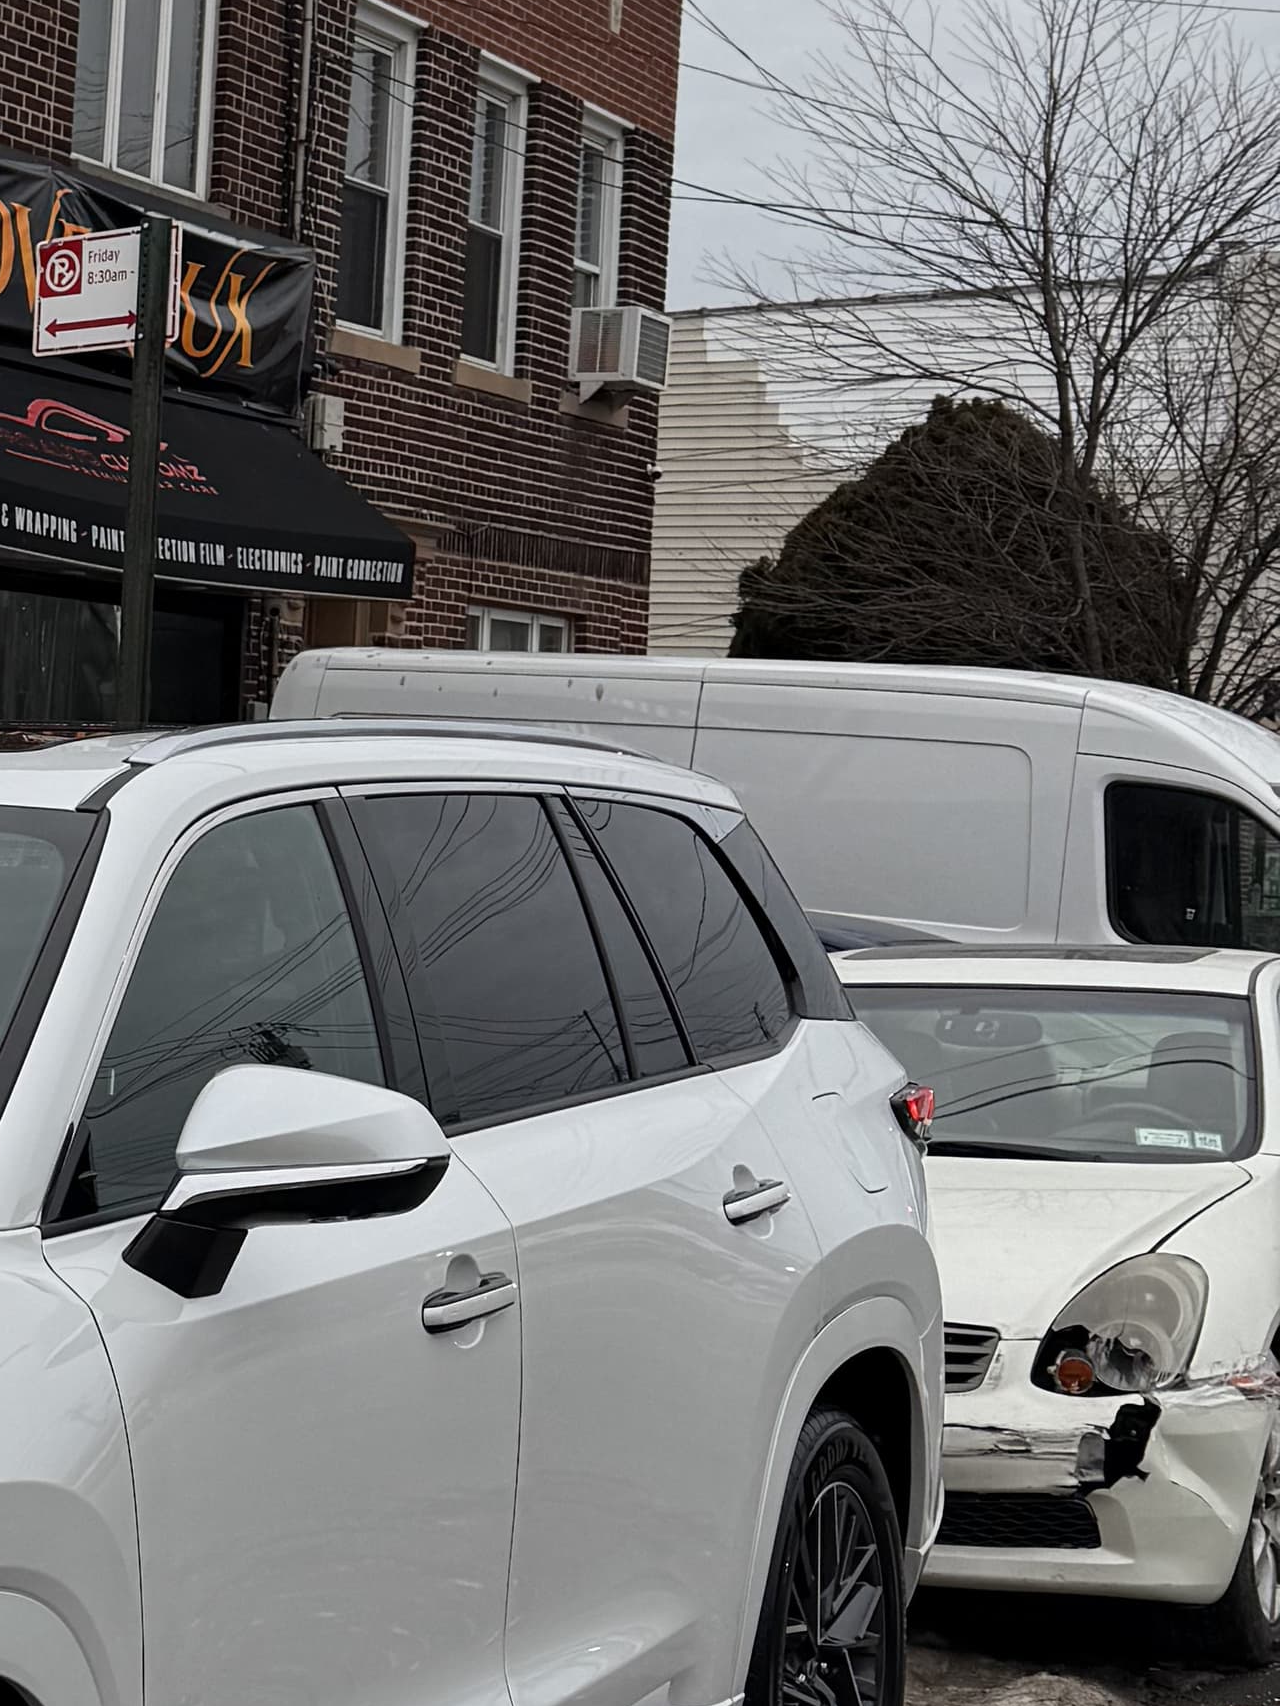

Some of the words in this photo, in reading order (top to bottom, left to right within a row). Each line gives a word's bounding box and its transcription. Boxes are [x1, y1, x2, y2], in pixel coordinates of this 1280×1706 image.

[88, 247, 121, 266] Friday
[87, 270, 127, 285] 8:30am
[1, 503, 9, 528] &
[15, 506, 78, 544] WRAPPING
[91, 524, 126, 553] PAINT
[200, 542, 225, 567] FILM
[236, 546, 304, 575] ELECTRONICS
[314, 555, 344, 579] PAINT
[346, 558, 405, 584] CORRECTION
